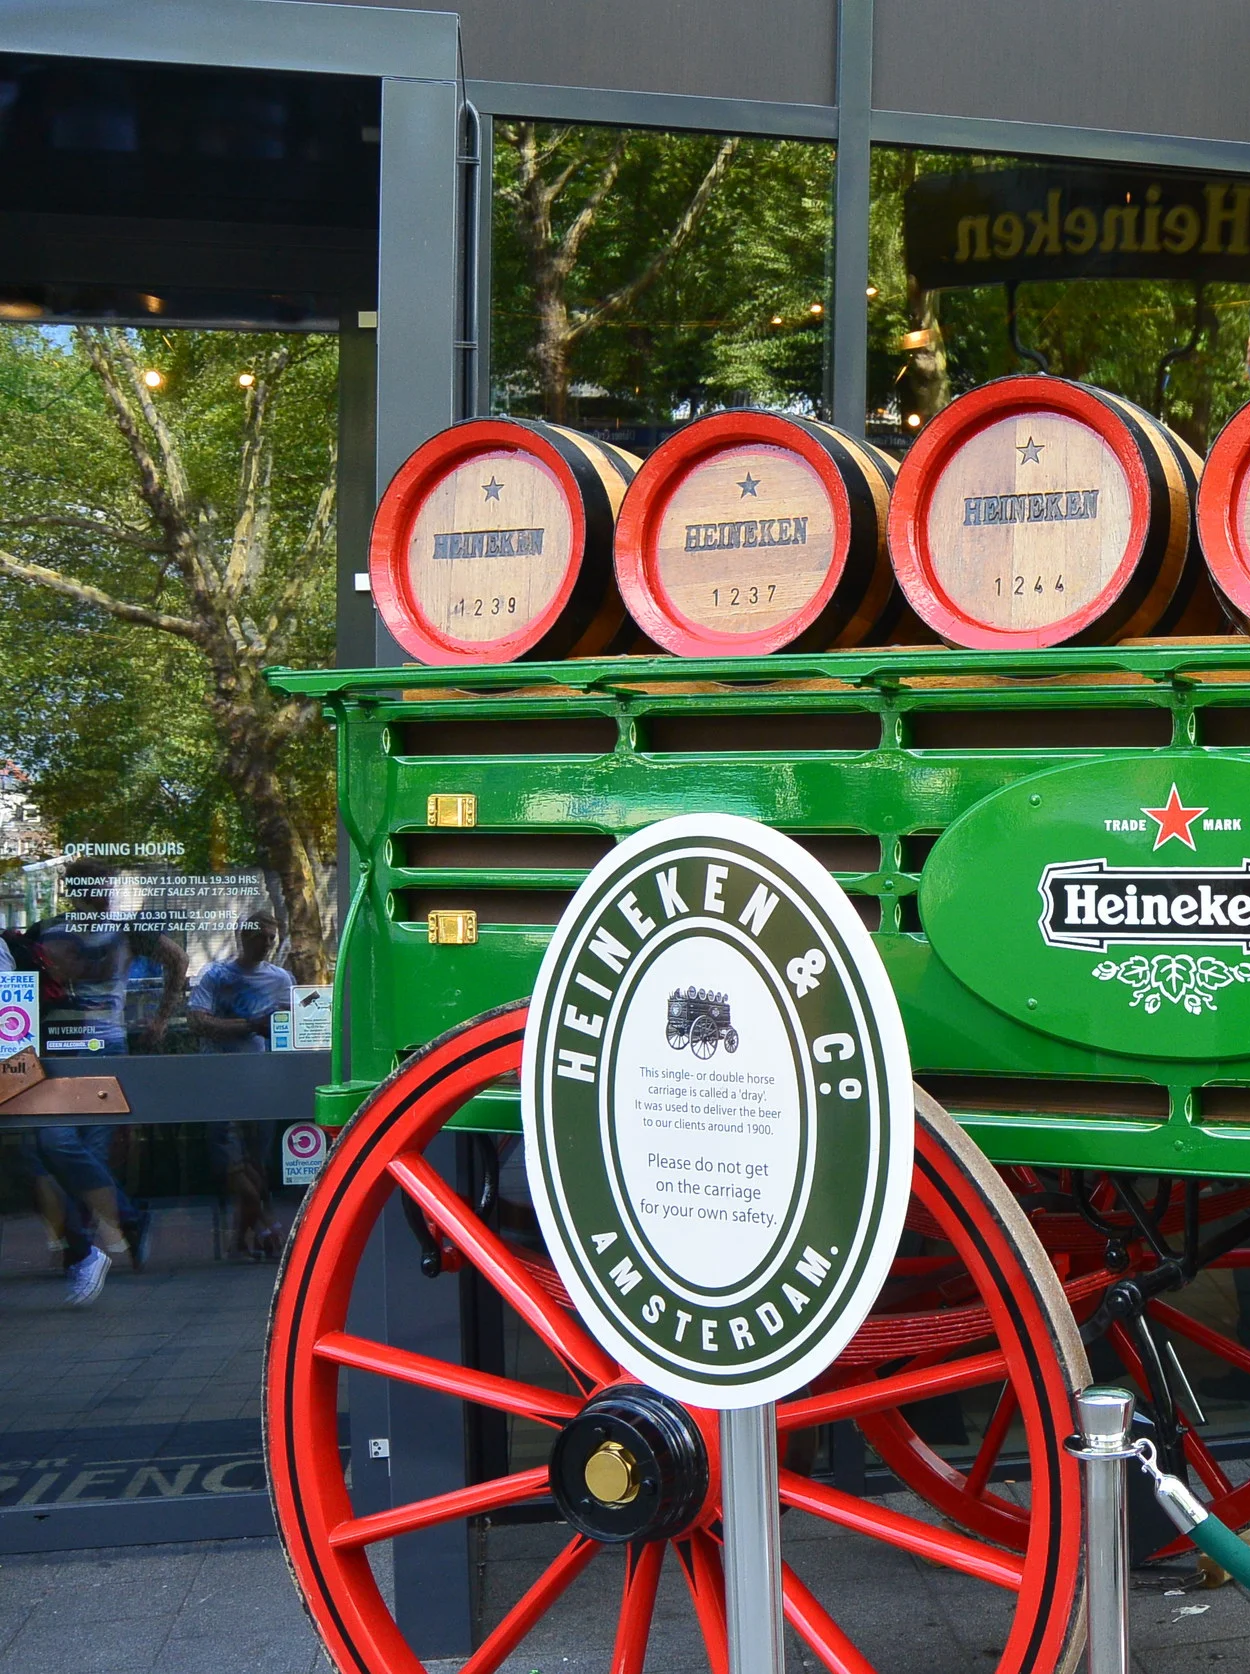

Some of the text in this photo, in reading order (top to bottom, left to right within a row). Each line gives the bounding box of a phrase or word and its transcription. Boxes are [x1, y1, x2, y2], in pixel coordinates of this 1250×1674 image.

[962, 489, 1100, 527] HEINEKEN
[432, 527, 545, 560] HEINEKEN
[684, 516, 809, 553] HEINEKEN
[994, 573, 1066, 597] 1244
[712, 583, 778, 607] 1237
[458, 596, 517, 617] 1239
[1104, 819, 1242, 831] TRADE MARK
[64, 842, 185, 856] OPENING HOURS
[65, 875, 260, 886] MONDAY-THURSDAY 11.00 TILL 19.30 HRS.
[65, 889, 88, 898] LAST
[90, 888, 121, 897] ENTRY
[133, 888, 166, 897] TICKET
[167, 887, 196, 897] SALES
[197, 887, 209, 896] AT
[212, 887, 238, 896] 17.30
[240, 887, 261, 896] HRS.
[65, 910, 239, 921] FRIDAY-SUNDAY 10.30 TILL 21.00 HRS.
[65, 922, 261, 933] LAST ENTRY & TICKET SALES AT 19.00 HRS.
[0, 975, 35, 983] X-FREE
[556, 863, 781, 1084] HEINEKEN
[785, 947, 827, 999] &
[1, 989, 34, 1003] 014
[48, 1027, 60, 1035] WIJ
[2, 1062, 26, 1074] Pull
[639, 1066, 775, 1085] This single- or double horse
[648, 1084, 687, 1098] carriage
[689, 1086, 697, 1097] is
[699, 1086, 729, 1099] called
[730, 1091, 737, 1099] a
[634, 1099, 782, 1119] It was used to deliver the beer
[643, 1117, 774, 1136] to our clients around 1900.
[286, 1167, 303, 1175] TAX
[648, 1153, 769, 1179] Please do not get
[656, 1178, 761, 1203] on the carriage
[640, 1198, 777, 1229] for your own safety.
[590, 1231, 839, 1353] AMSTERDAM.
